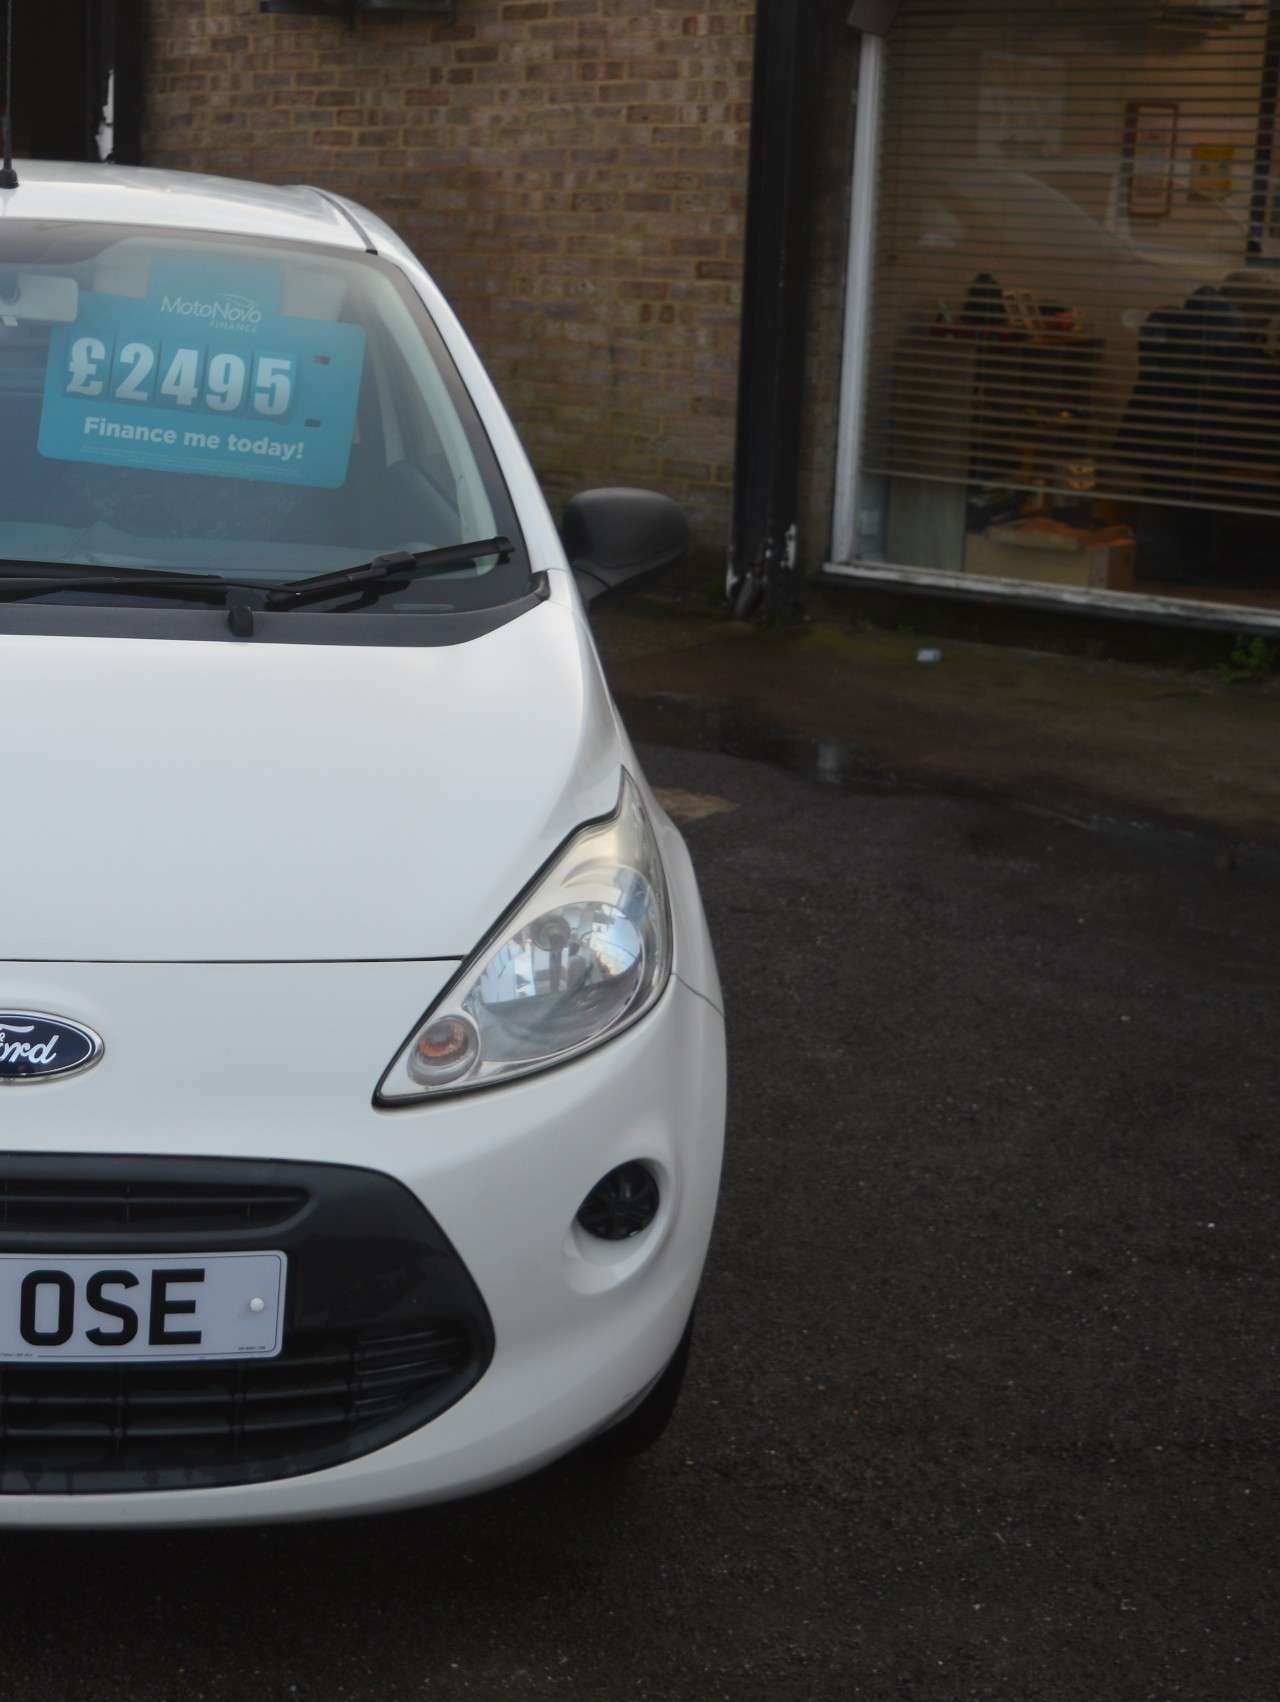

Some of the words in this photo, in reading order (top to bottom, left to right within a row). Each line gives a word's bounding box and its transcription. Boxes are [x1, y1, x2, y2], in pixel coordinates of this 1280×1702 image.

[160, 295, 262, 323] MotoNovo
[208, 319, 257, 334] FINANCE
[65, 336, 292, 416] £2495
[83, 416, 178, 445] Finance
[183, 430, 221, 449] me
[227, 433, 305, 461] today!
[19, 1267, 206, 1347] OSE
